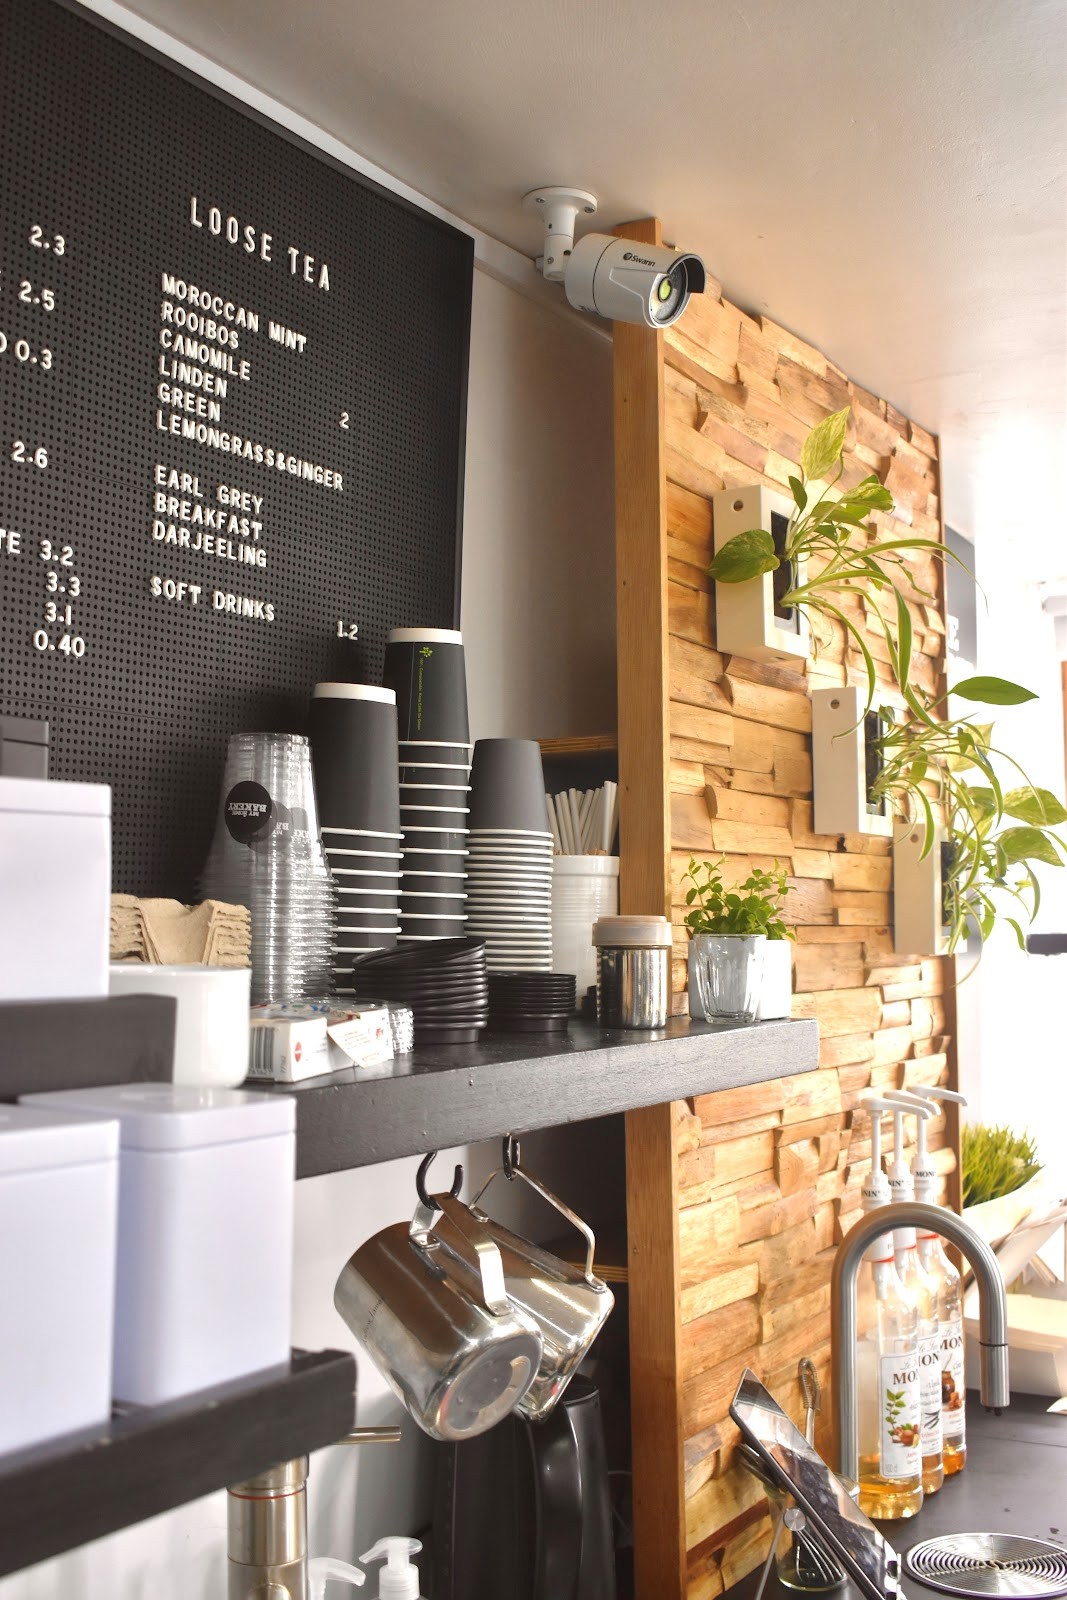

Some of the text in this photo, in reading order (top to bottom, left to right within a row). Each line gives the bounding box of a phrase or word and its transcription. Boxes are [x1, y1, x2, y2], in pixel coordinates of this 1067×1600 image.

[29, 224, 66, 257] 2.3
[190, 196, 331, 292] LOOSE TEA
[631, 255, 656, 267] Swann
[18, 280, 55, 312] 2.5
[161, 272, 307, 353] MOROCCAN MINT
[160, 300, 240, 350] ROOIBOS
[15, 339, 53, 371] 0.3
[158, 328, 251, 381] CAMOMILE
[158, 354, 228, 399] LINDEN
[157, 382, 221, 423] GREEN
[338, 411, 350, 430] 2
[11, 440, 49, 469] 2.6
[156, 409, 345, 492] LEMONGRASS&GINGER
[154, 464, 264, 516] EARL GREY
[153, 491, 264, 542] BREAKFAST
[39, 539, 75, 567] 3.2
[152, 519, 268, 568] DARJEELING
[46, 571, 81, 598] 3.3
[150, 575, 276, 623] SOFT DRINKS
[44, 601, 73, 626] 3.1
[33, 629, 86, 659] 0.40
[336, 620, 359, 641] 1.2
[228, 803, 267, 812] BAKERY
